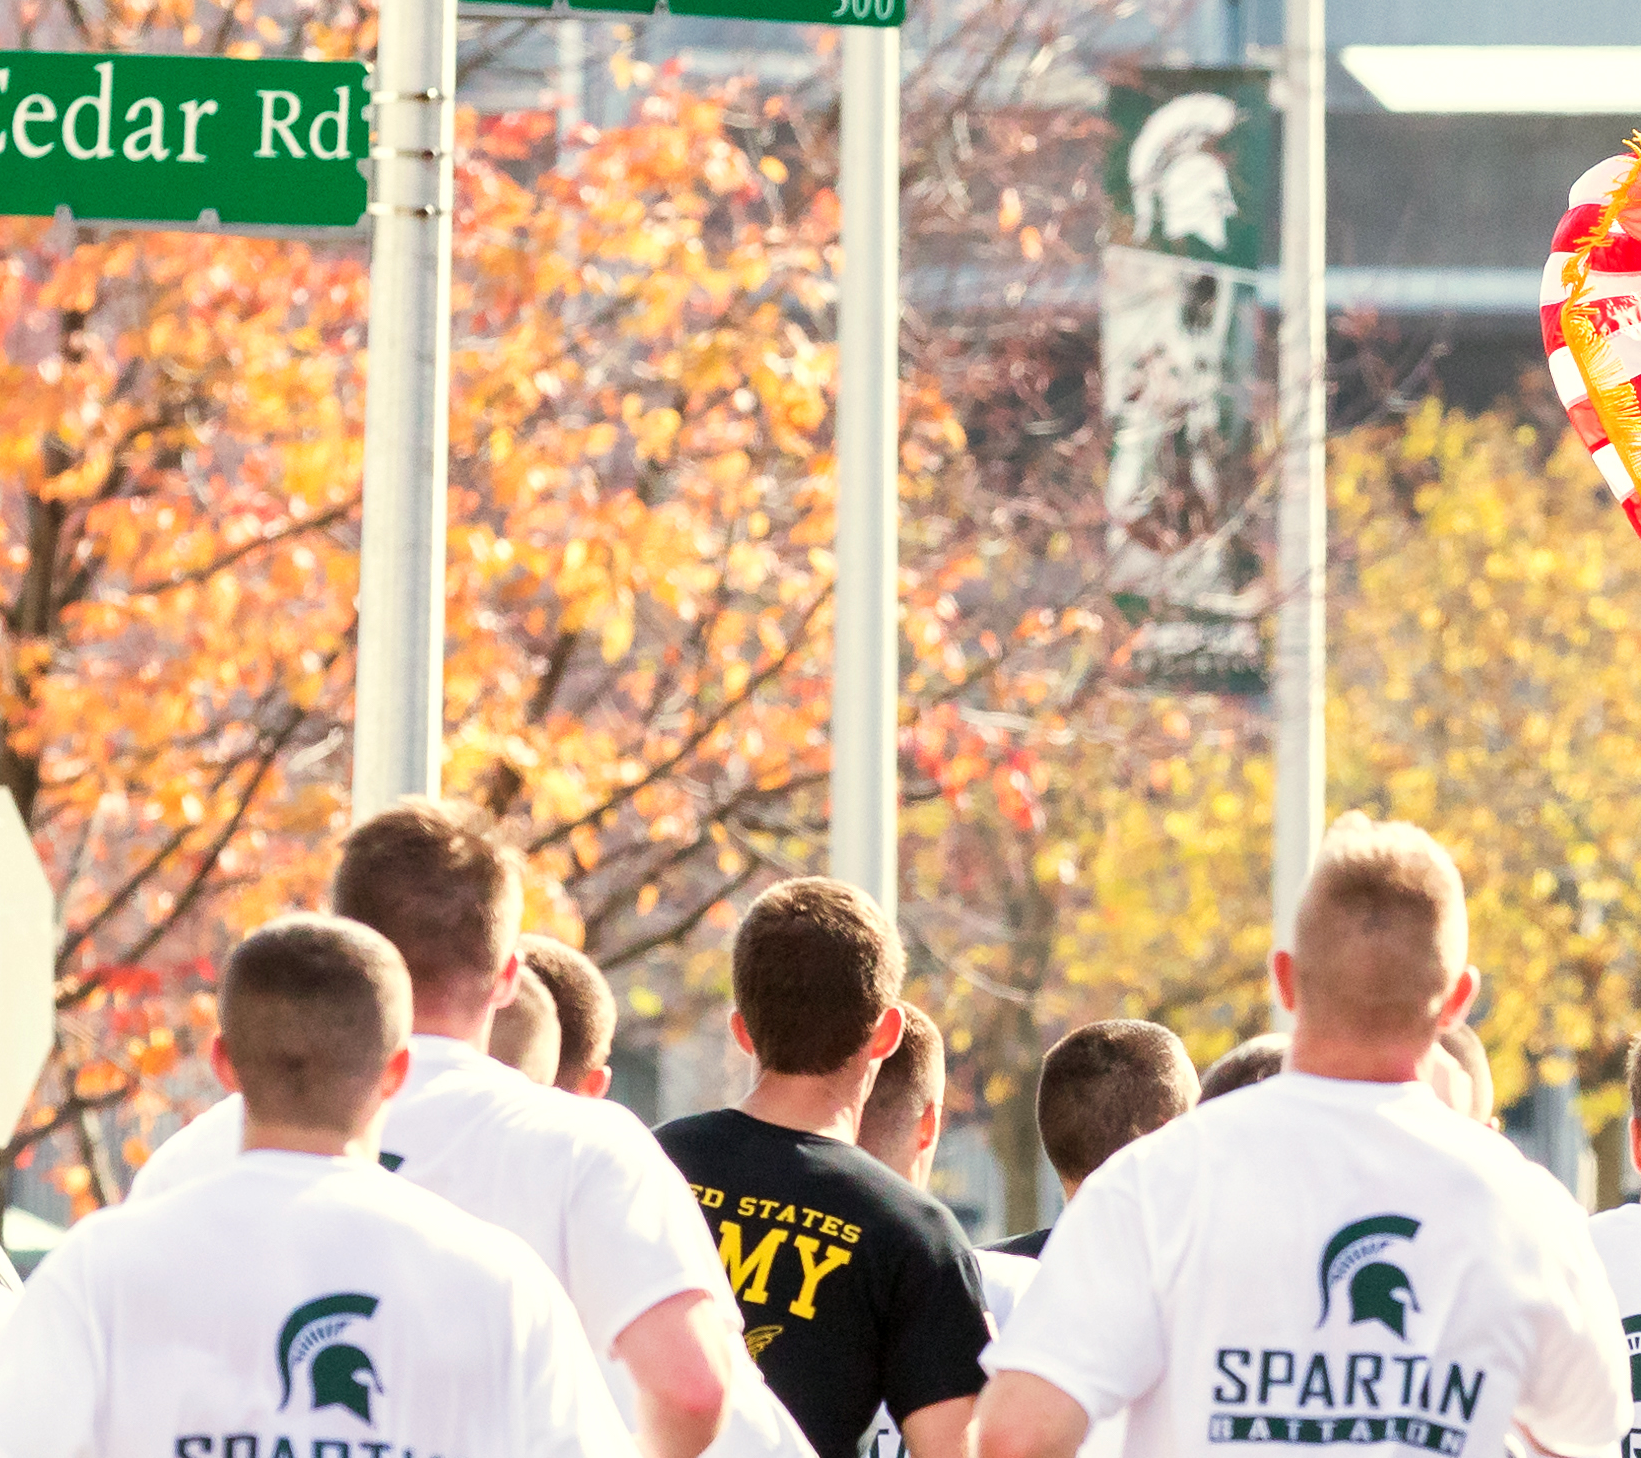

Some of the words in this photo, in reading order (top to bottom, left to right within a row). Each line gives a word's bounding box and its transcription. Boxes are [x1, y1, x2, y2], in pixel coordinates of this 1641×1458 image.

[254, 86, 353, 160] Rd
[737, 1197, 862, 1244] STATES
[718, 1220, 853, 1320] MY
